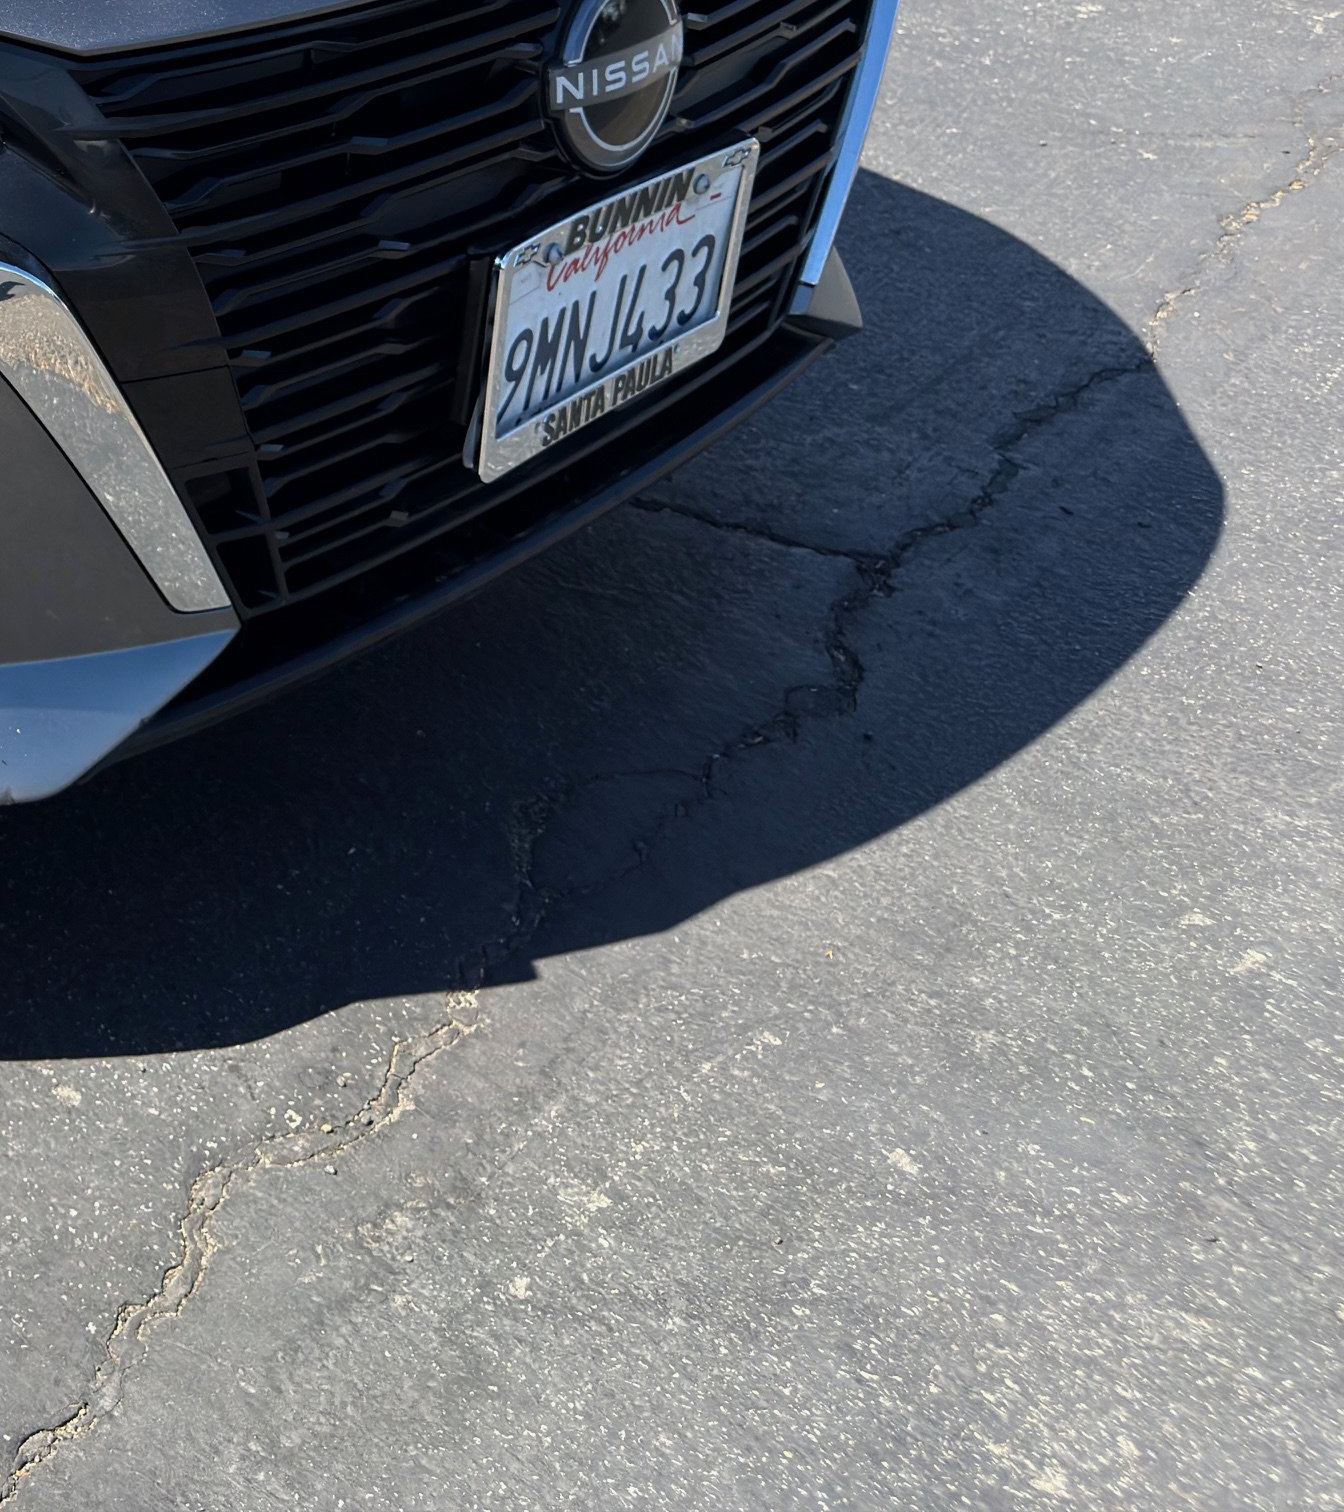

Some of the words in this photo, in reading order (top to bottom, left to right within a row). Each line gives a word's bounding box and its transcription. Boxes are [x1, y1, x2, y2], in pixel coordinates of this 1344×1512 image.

[555, 32, 684, 106] NISSAN
[546, 202, 696, 293] California
[565, 167, 696, 256] BUNNIN
[496, 233, 716, 426] 9MNJ433
[541, 384, 606, 447] SANTA
[612, 345, 674, 409] PAULA
